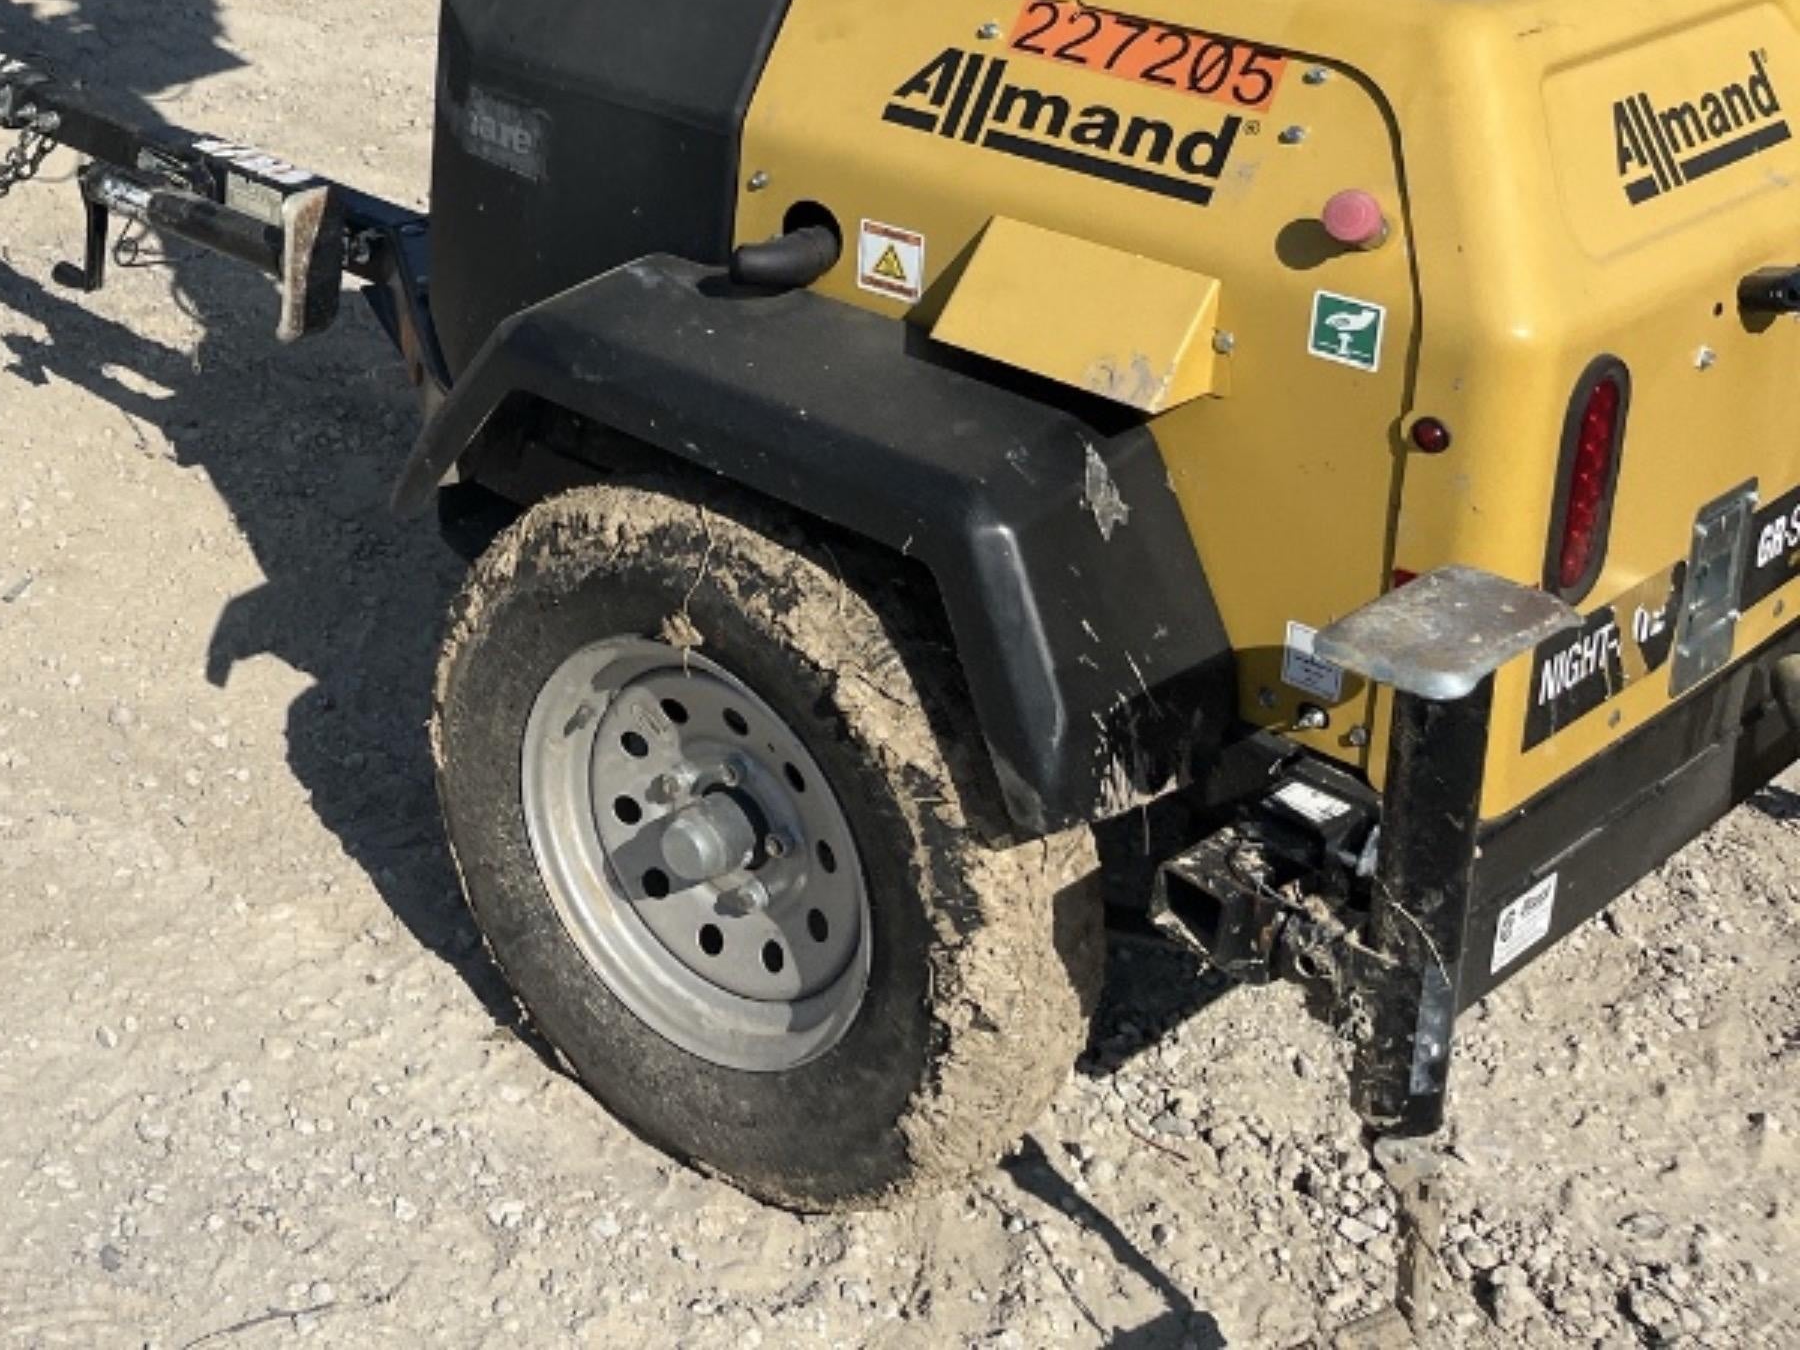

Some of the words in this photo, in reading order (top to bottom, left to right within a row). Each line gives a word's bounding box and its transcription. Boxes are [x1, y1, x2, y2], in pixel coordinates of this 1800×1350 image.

[893, 47, 1243, 180] Allmand
[1011, 1, 1284, 106] 227205
[1613, 50, 1780, 192] Allmand
